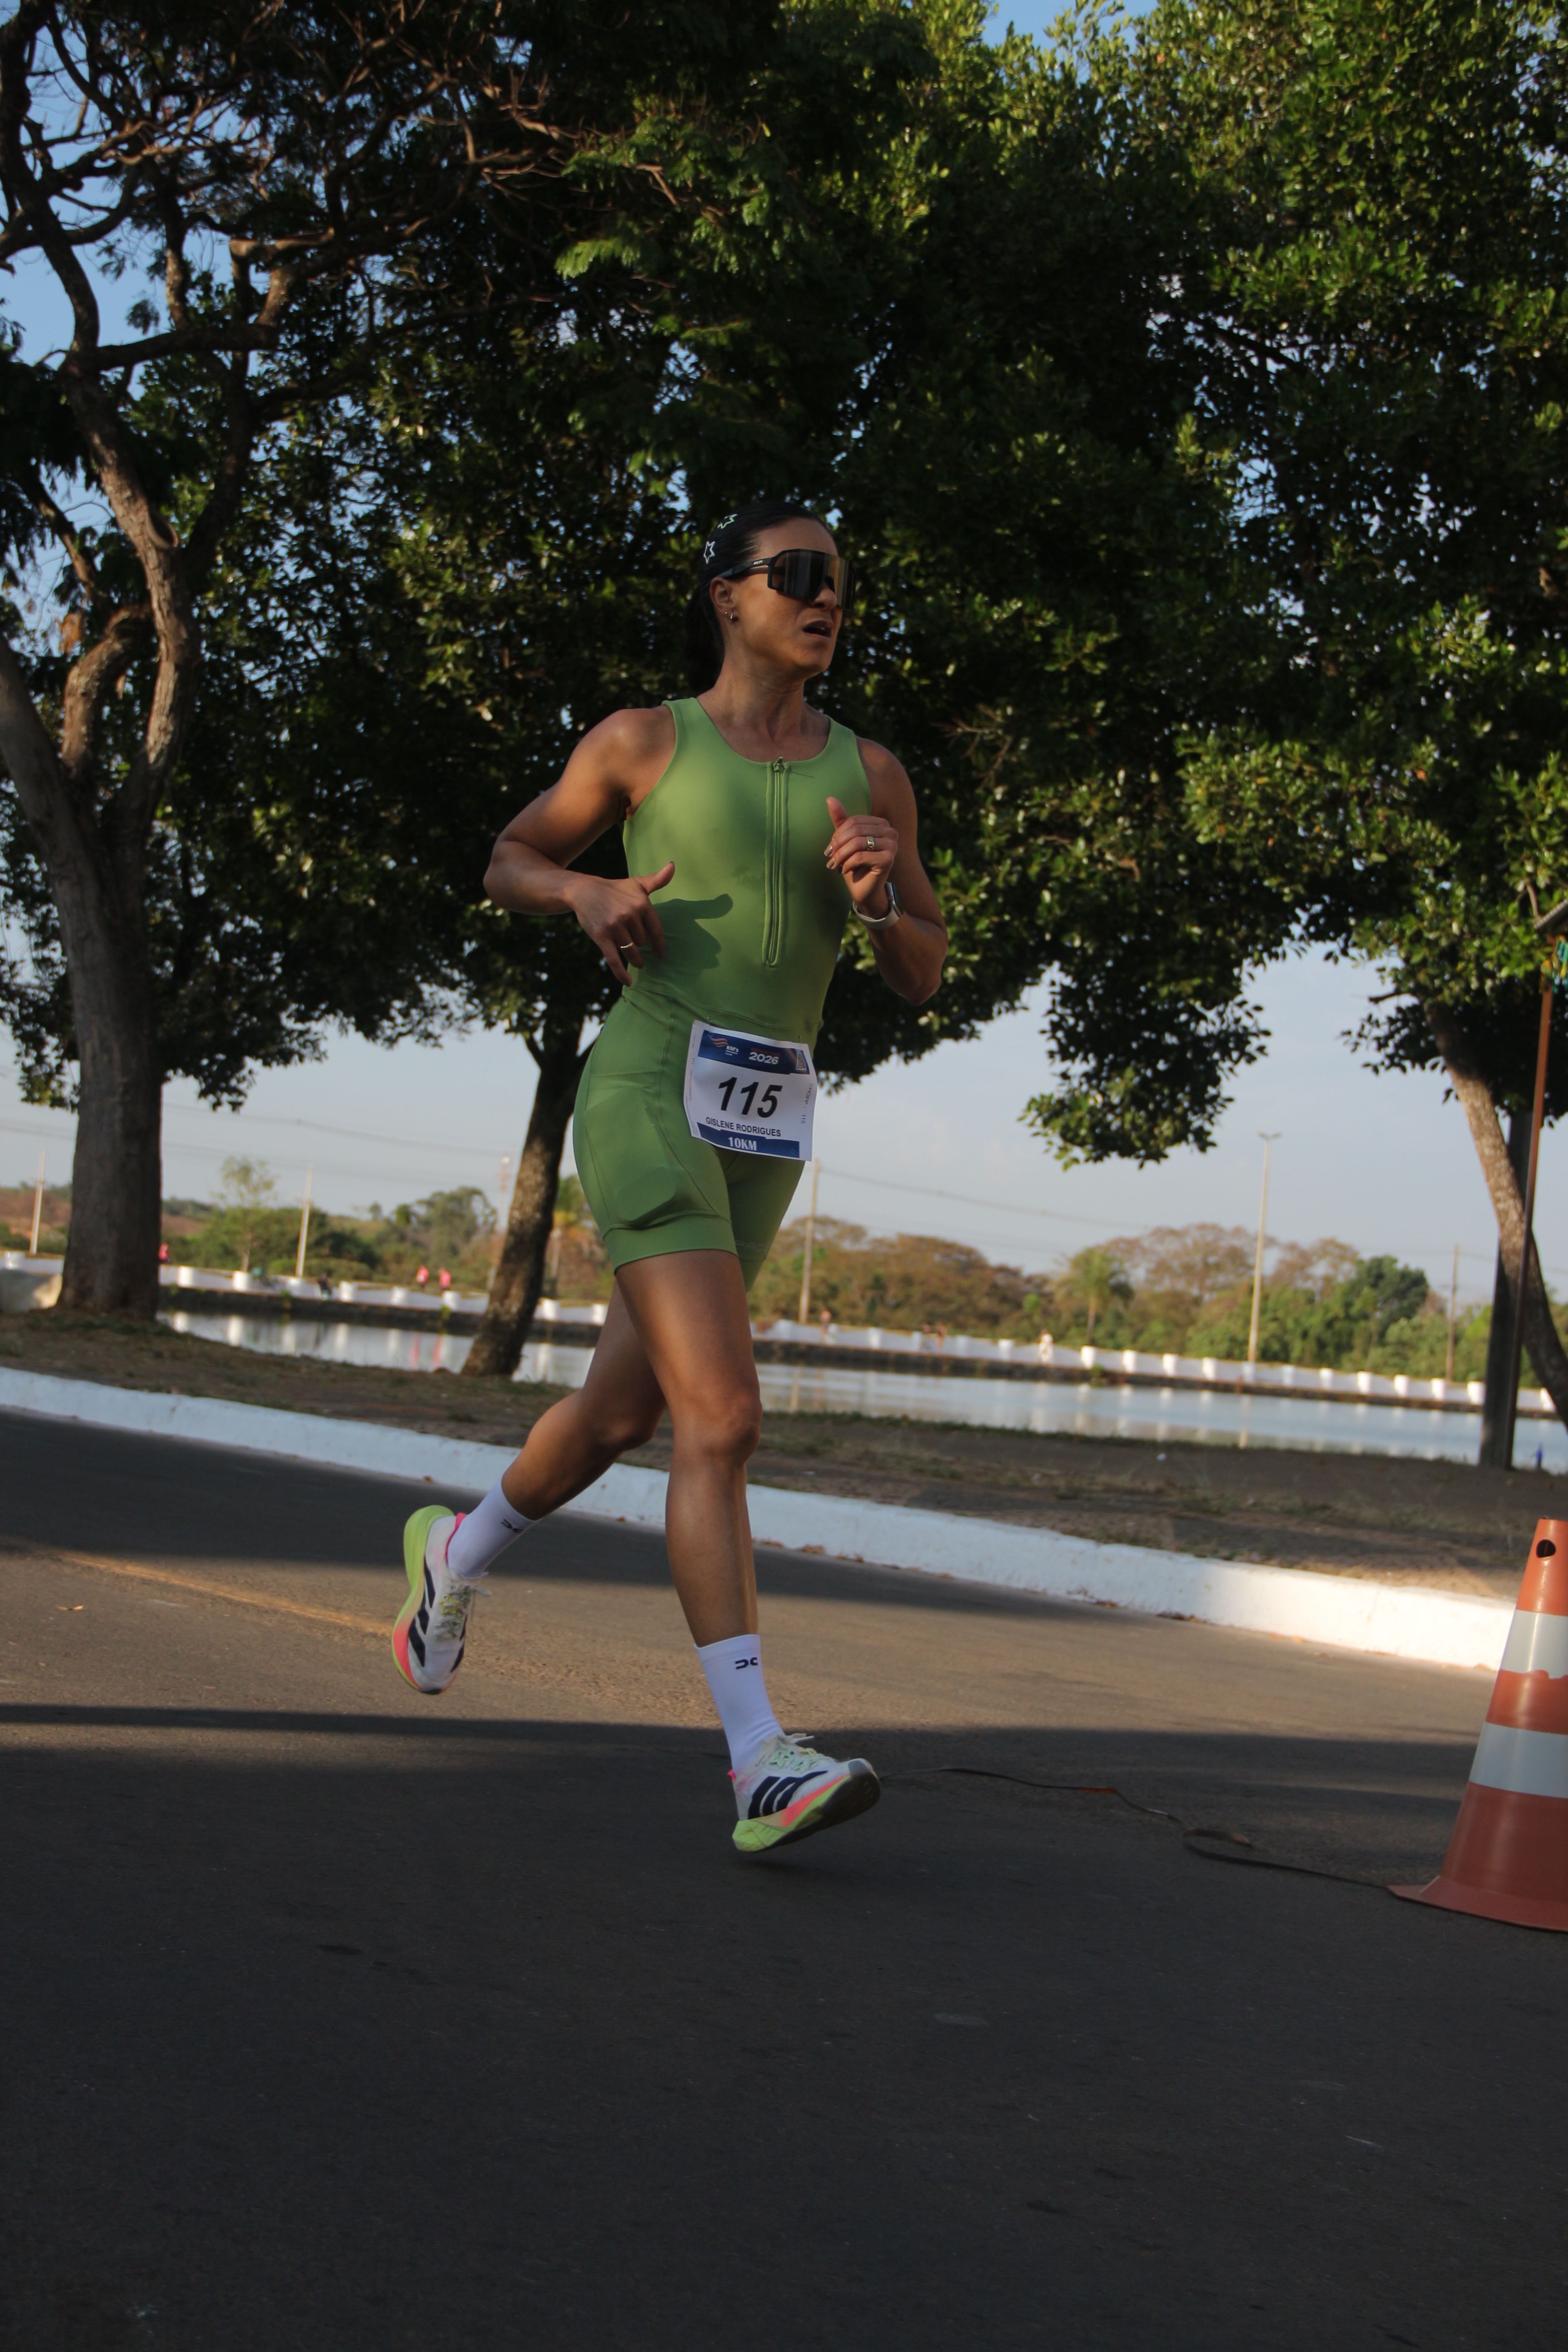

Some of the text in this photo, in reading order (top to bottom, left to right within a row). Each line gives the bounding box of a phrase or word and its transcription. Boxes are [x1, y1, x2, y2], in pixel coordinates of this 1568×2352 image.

[749, 1052, 779, 1064] 2026
[718, 1077, 783, 1118] 115
[706, 1117, 781, 1137] GISLENE RODRIGUES
[728, 1137, 757, 1151] 10KM
